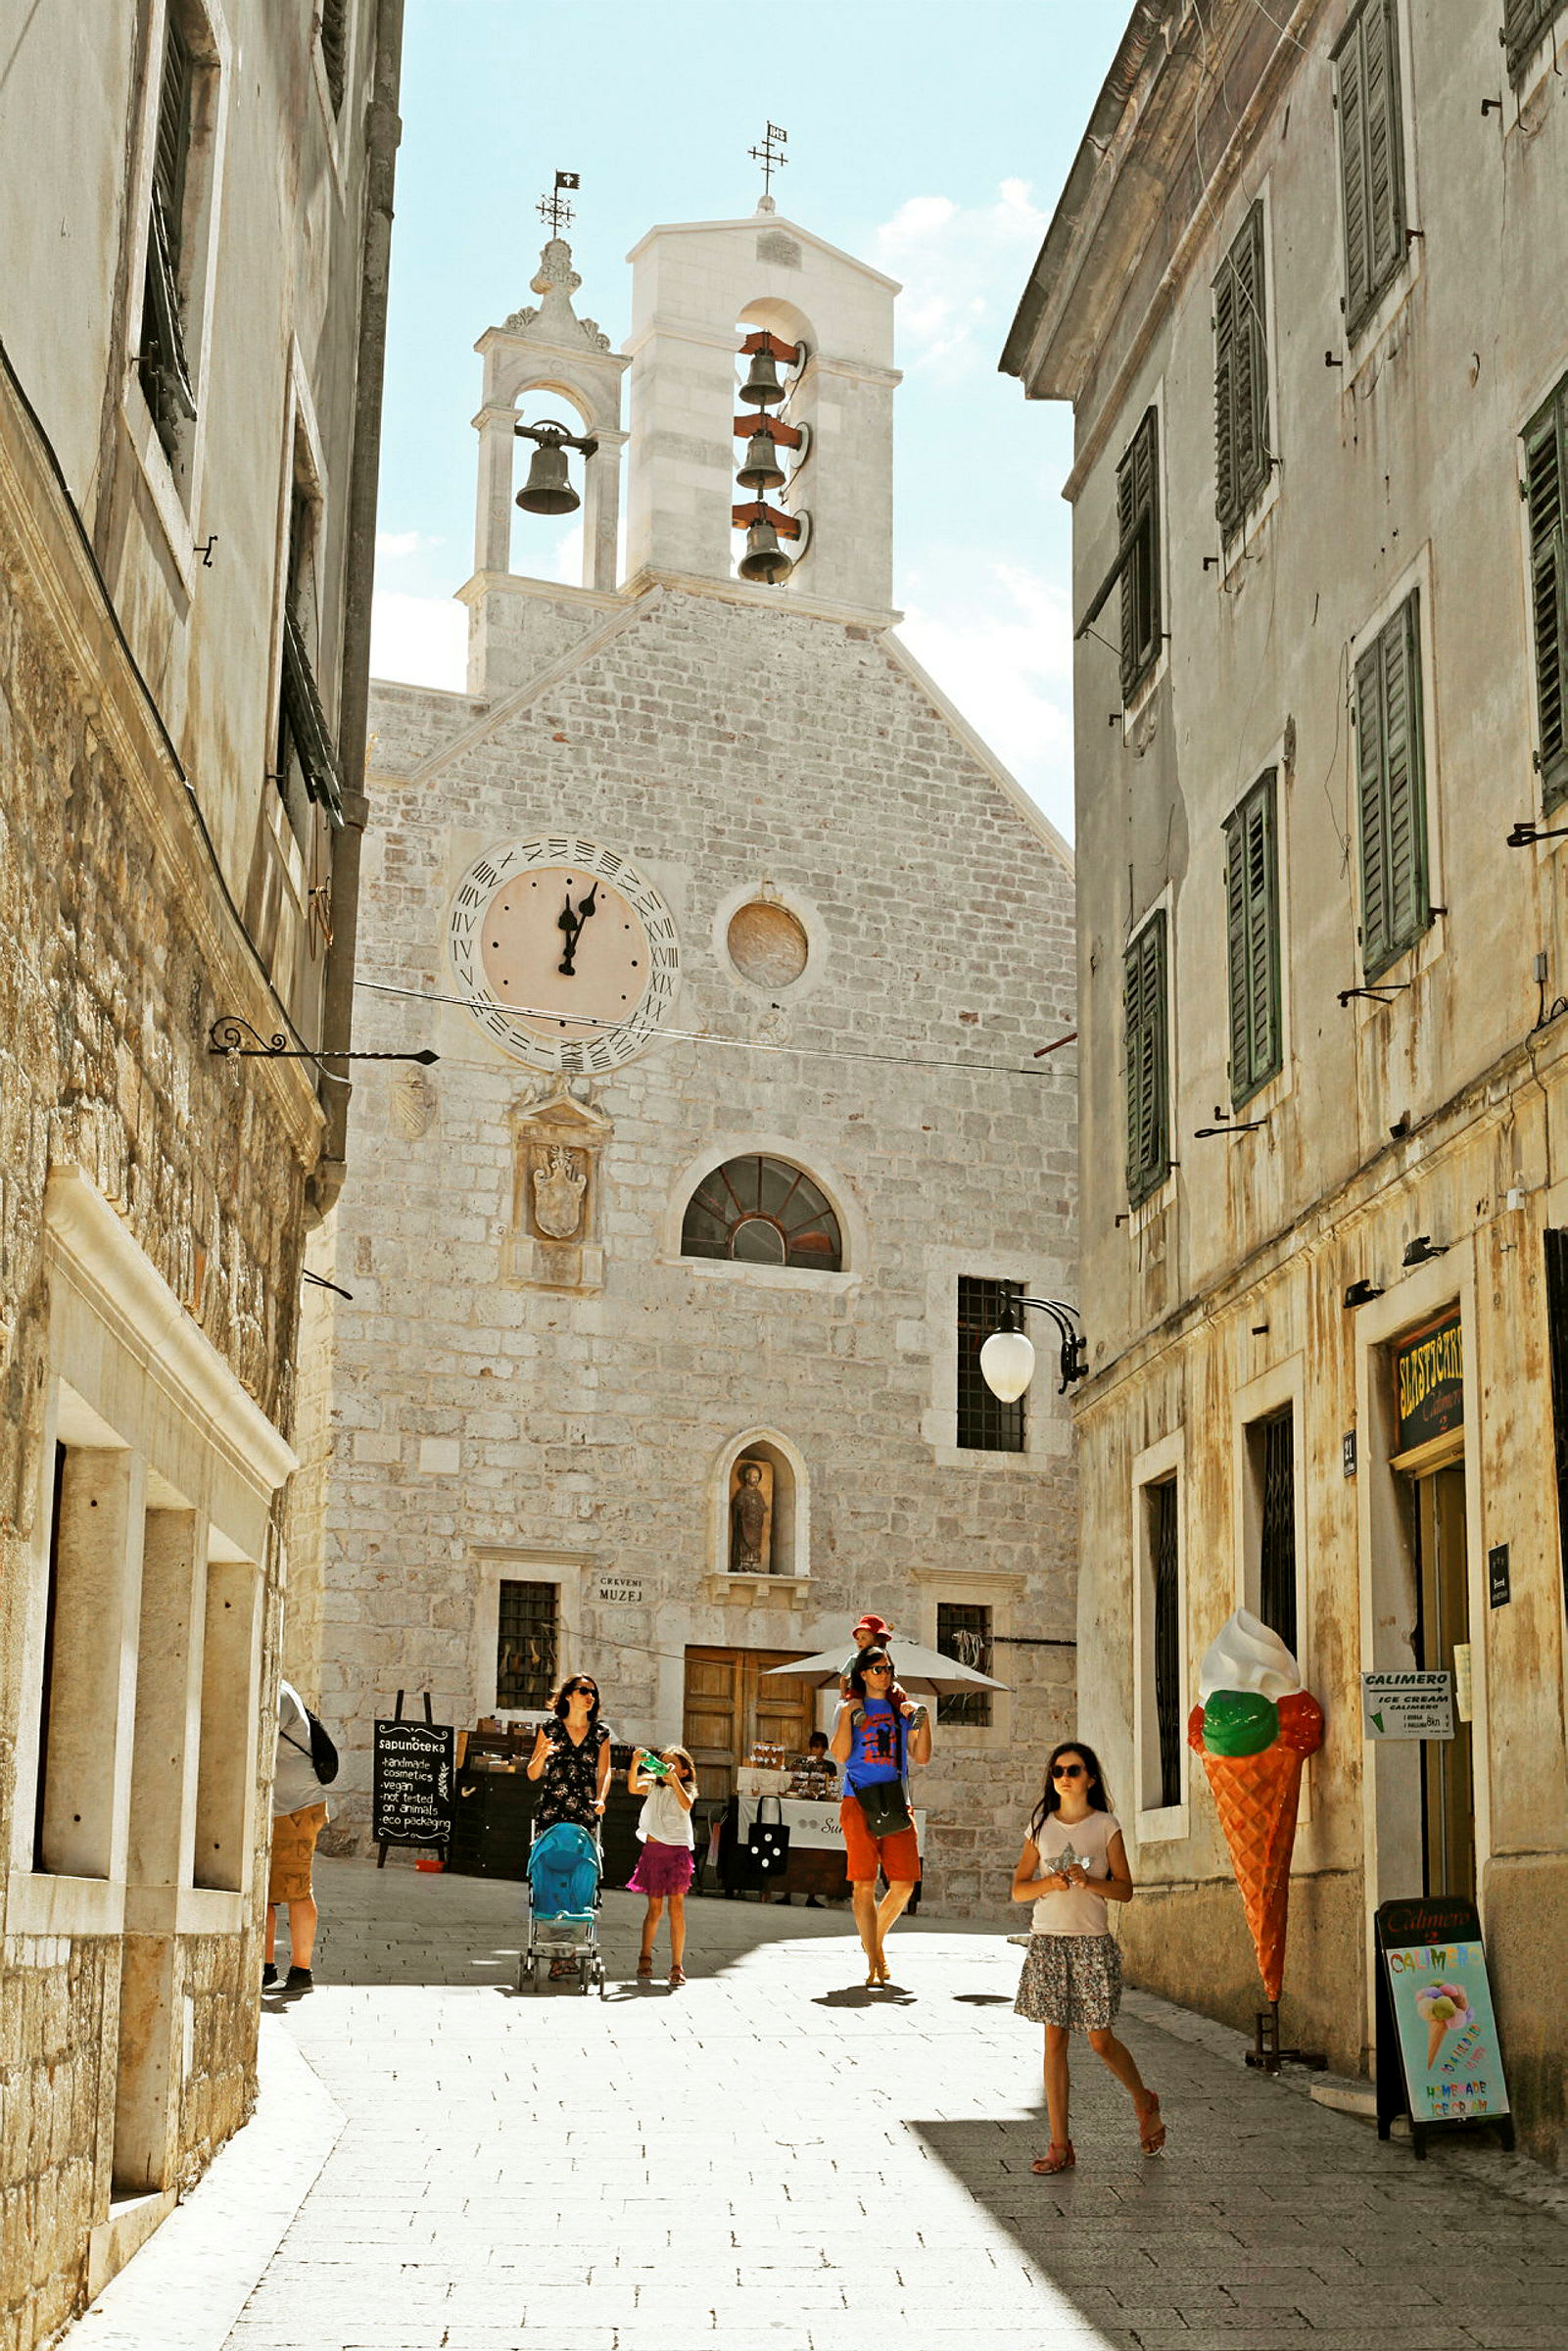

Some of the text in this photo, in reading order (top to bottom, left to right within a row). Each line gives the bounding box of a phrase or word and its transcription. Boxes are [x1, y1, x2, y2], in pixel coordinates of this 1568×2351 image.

[770, 124, 785, 141] IHS
[599, 1577, 642, 1588] CRKVENI
[599, 1589, 642, 1602] MUZEJ
[1365, 1674, 1448, 1685] CALIMERO
[383, 1769, 434, 1783] cosmetics
[382, 1803, 439, 1816] on animals
[404, 1816, 451, 1834] packaging
[1391, 1945, 1483, 1974] CALIMERO
[1426, 2080, 1488, 2100] HOMEMADE
